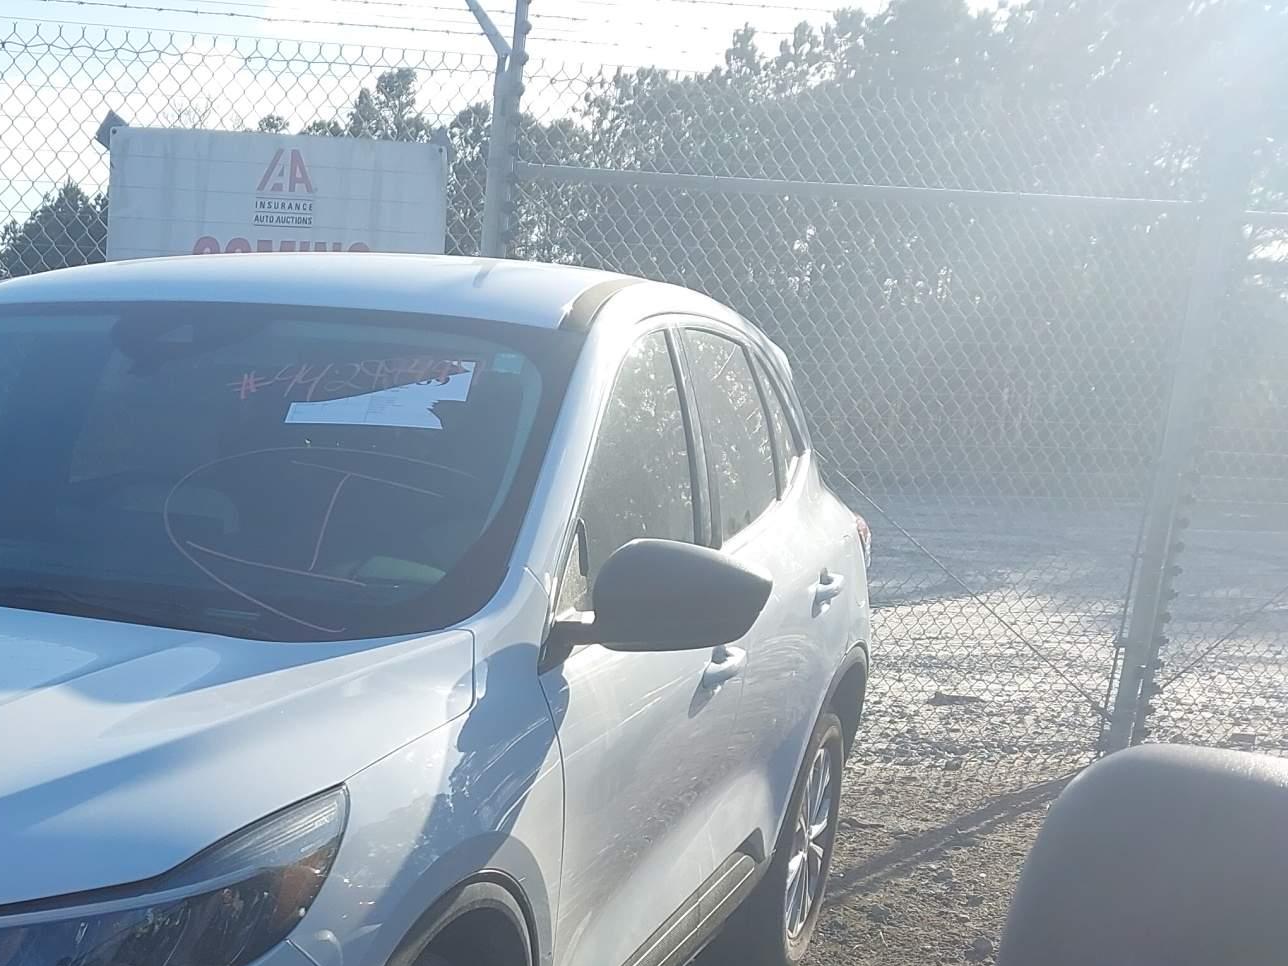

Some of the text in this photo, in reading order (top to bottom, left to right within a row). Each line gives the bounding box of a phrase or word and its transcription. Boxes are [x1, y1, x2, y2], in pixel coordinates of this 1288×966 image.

[255, 200, 313, 212] INSURANCE
[254, 213, 313, 226] AUTO AUCTIONS
